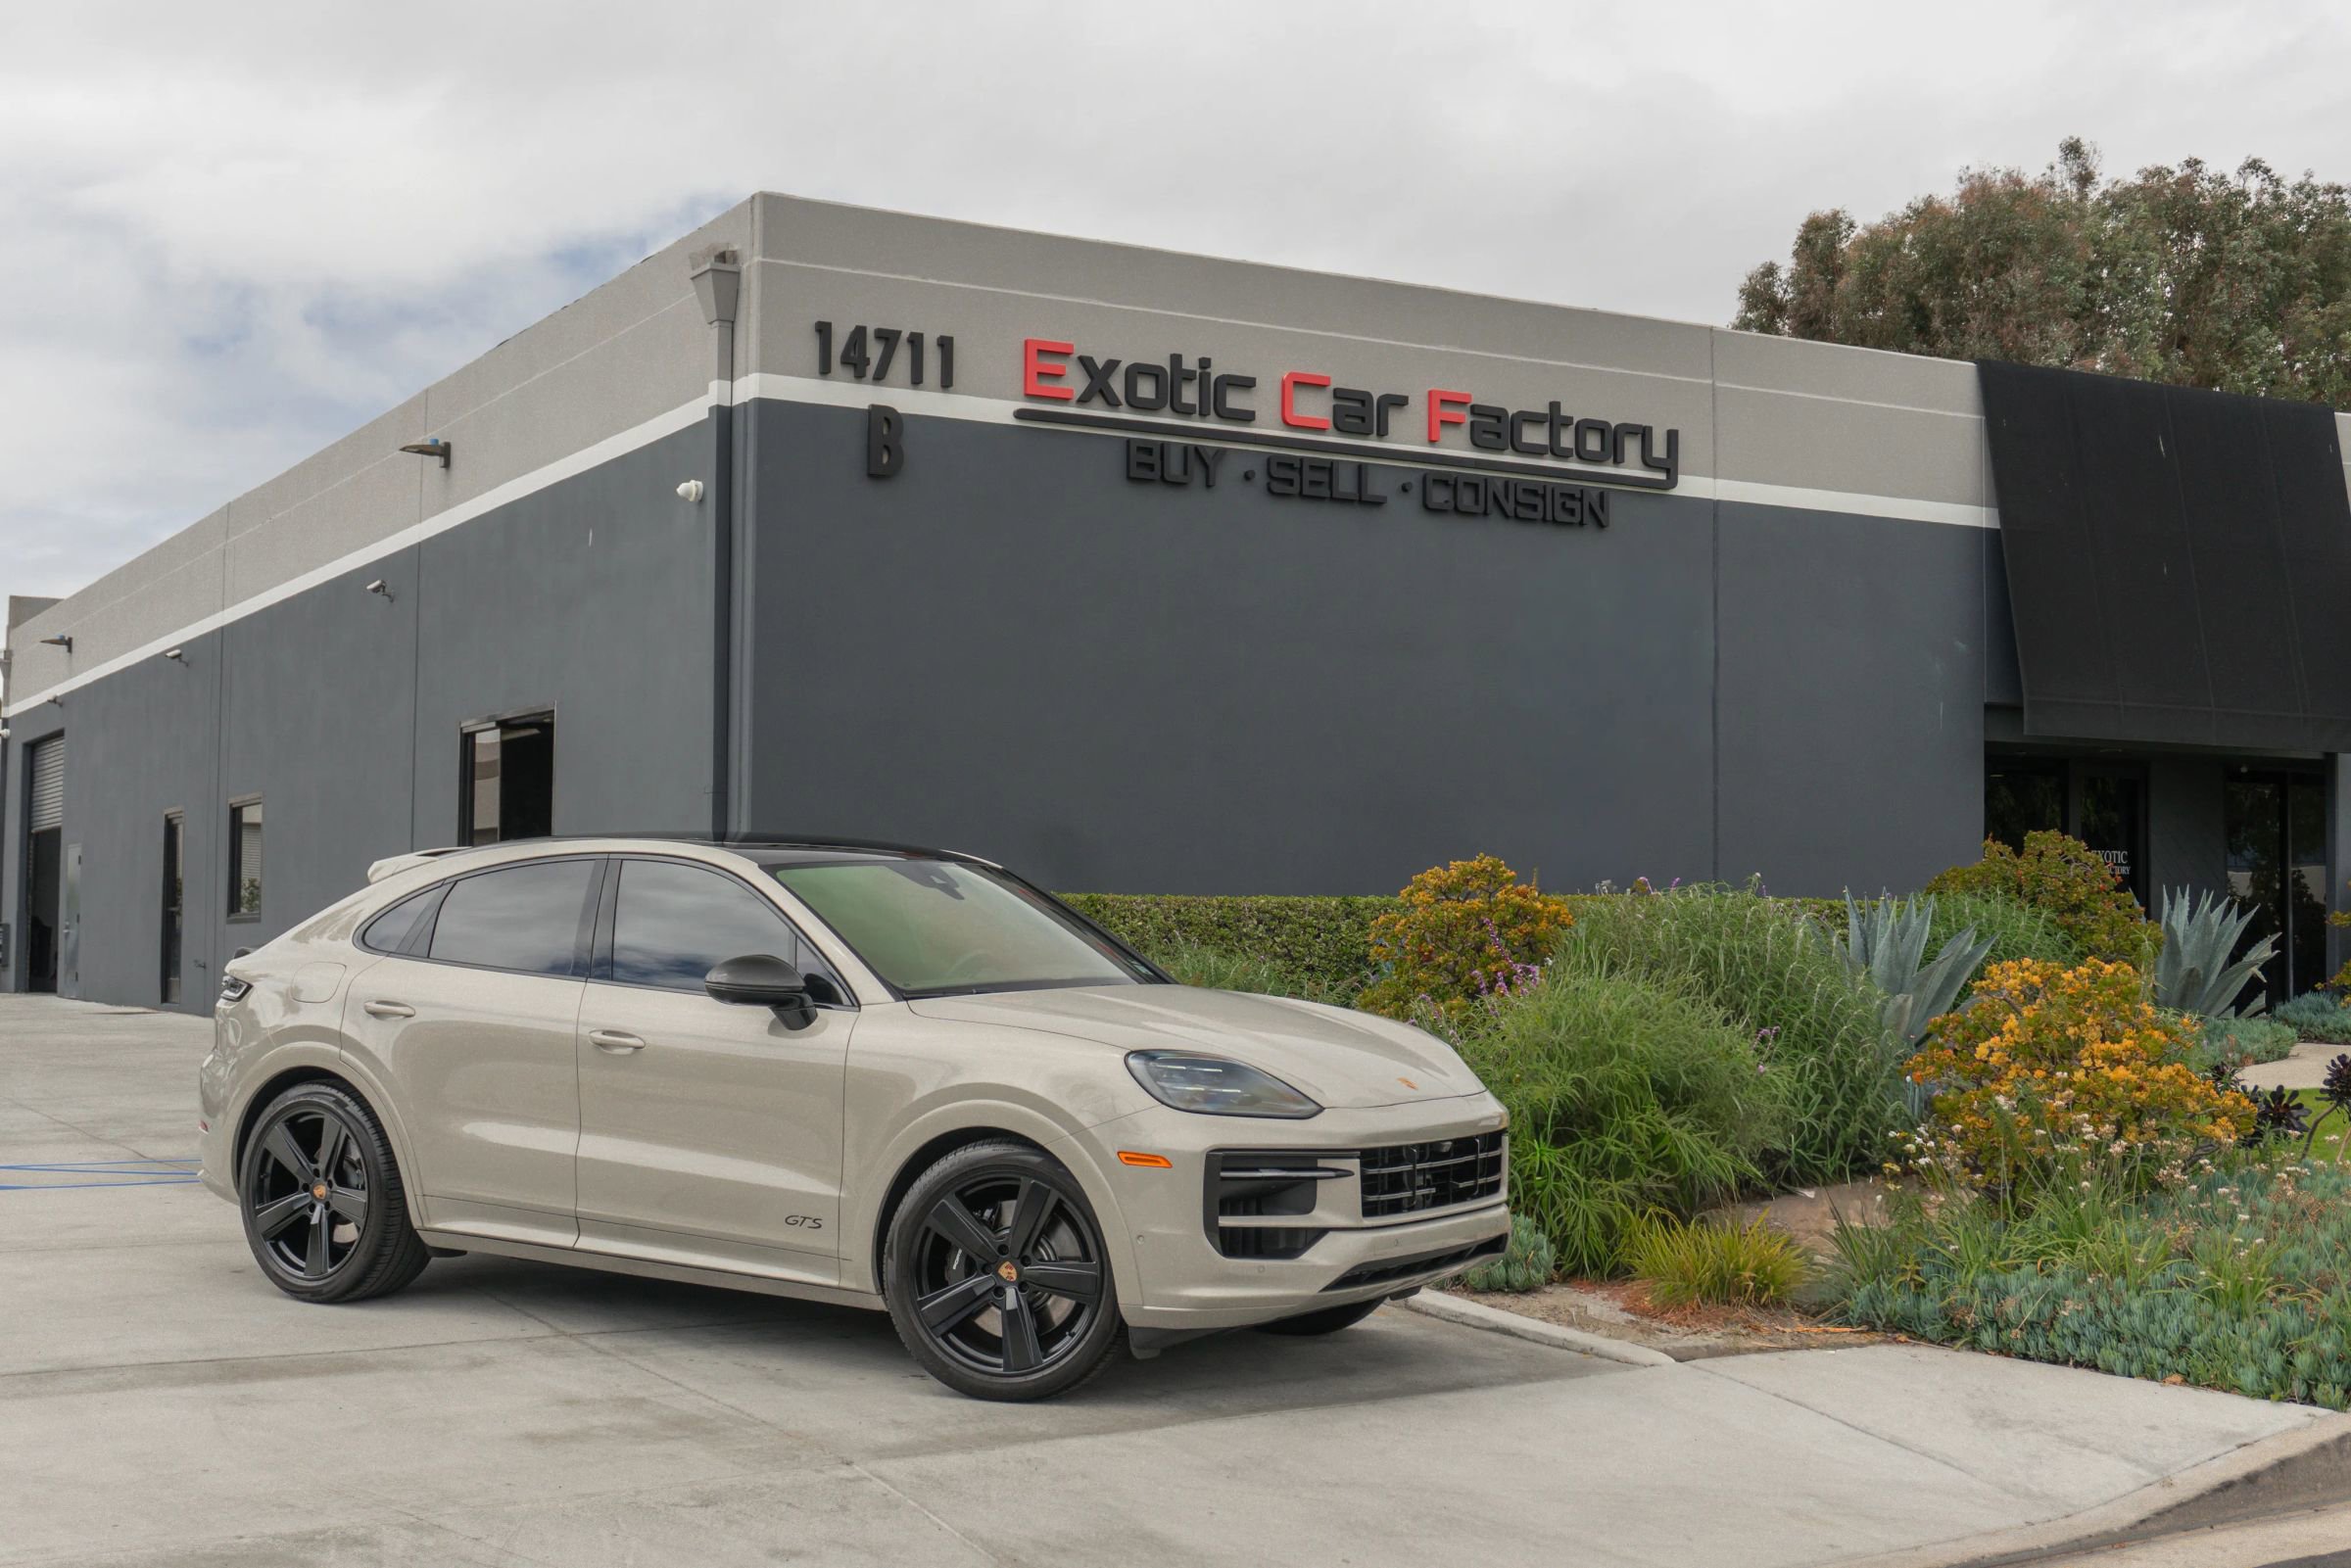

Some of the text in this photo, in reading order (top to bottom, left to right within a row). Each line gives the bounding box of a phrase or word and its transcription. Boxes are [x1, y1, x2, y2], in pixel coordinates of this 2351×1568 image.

[815, 320, 954, 388] 14711
[868, 404, 904, 478] B
[1024, 338, 1679, 490] Exotic Car Factory
[1126, 438, 1609, 528] BUY SELL CONSIGN
[785, 1214, 823, 1229] GTS
